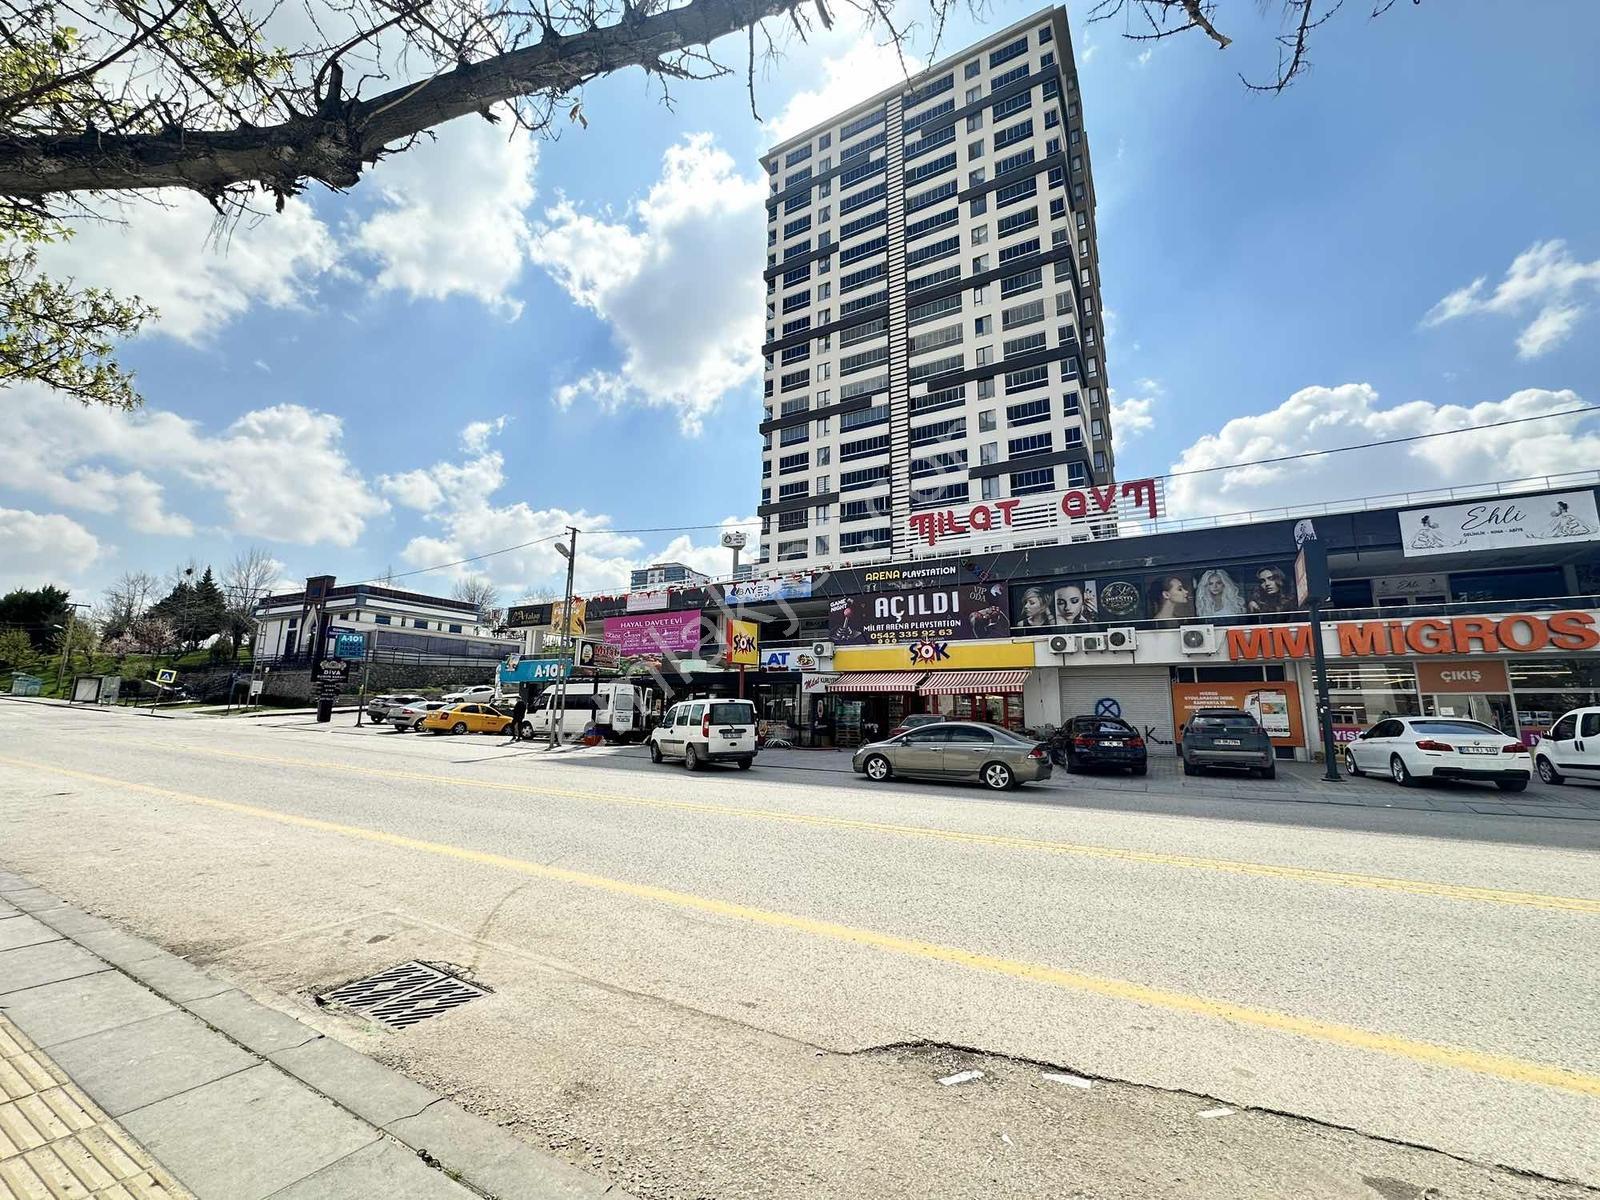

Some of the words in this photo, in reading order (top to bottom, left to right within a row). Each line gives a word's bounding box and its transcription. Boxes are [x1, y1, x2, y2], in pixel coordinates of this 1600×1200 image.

[1461, 505, 1527, 530] Ehli
[865, 570, 900, 582] ARENA
[902, 566, 956, 579] PLAYSTATION
[737, 585, 770, 596] BAYER
[973, 585, 987, 595] VIP
[969, 591, 986, 602] ODA
[874, 591, 959, 623] AÇILDI
[886, 622, 909, 630] ARENA
[911, 620, 961, 629] PLAYSTATION
[870, 632, 896, 640] 0542
[921, 629, 936, 637] 92
[938, 628, 953, 636] 63
[1226, 626, 1314, 661] MM
[1440, 671, 1482, 683] ÇIKIŞ
